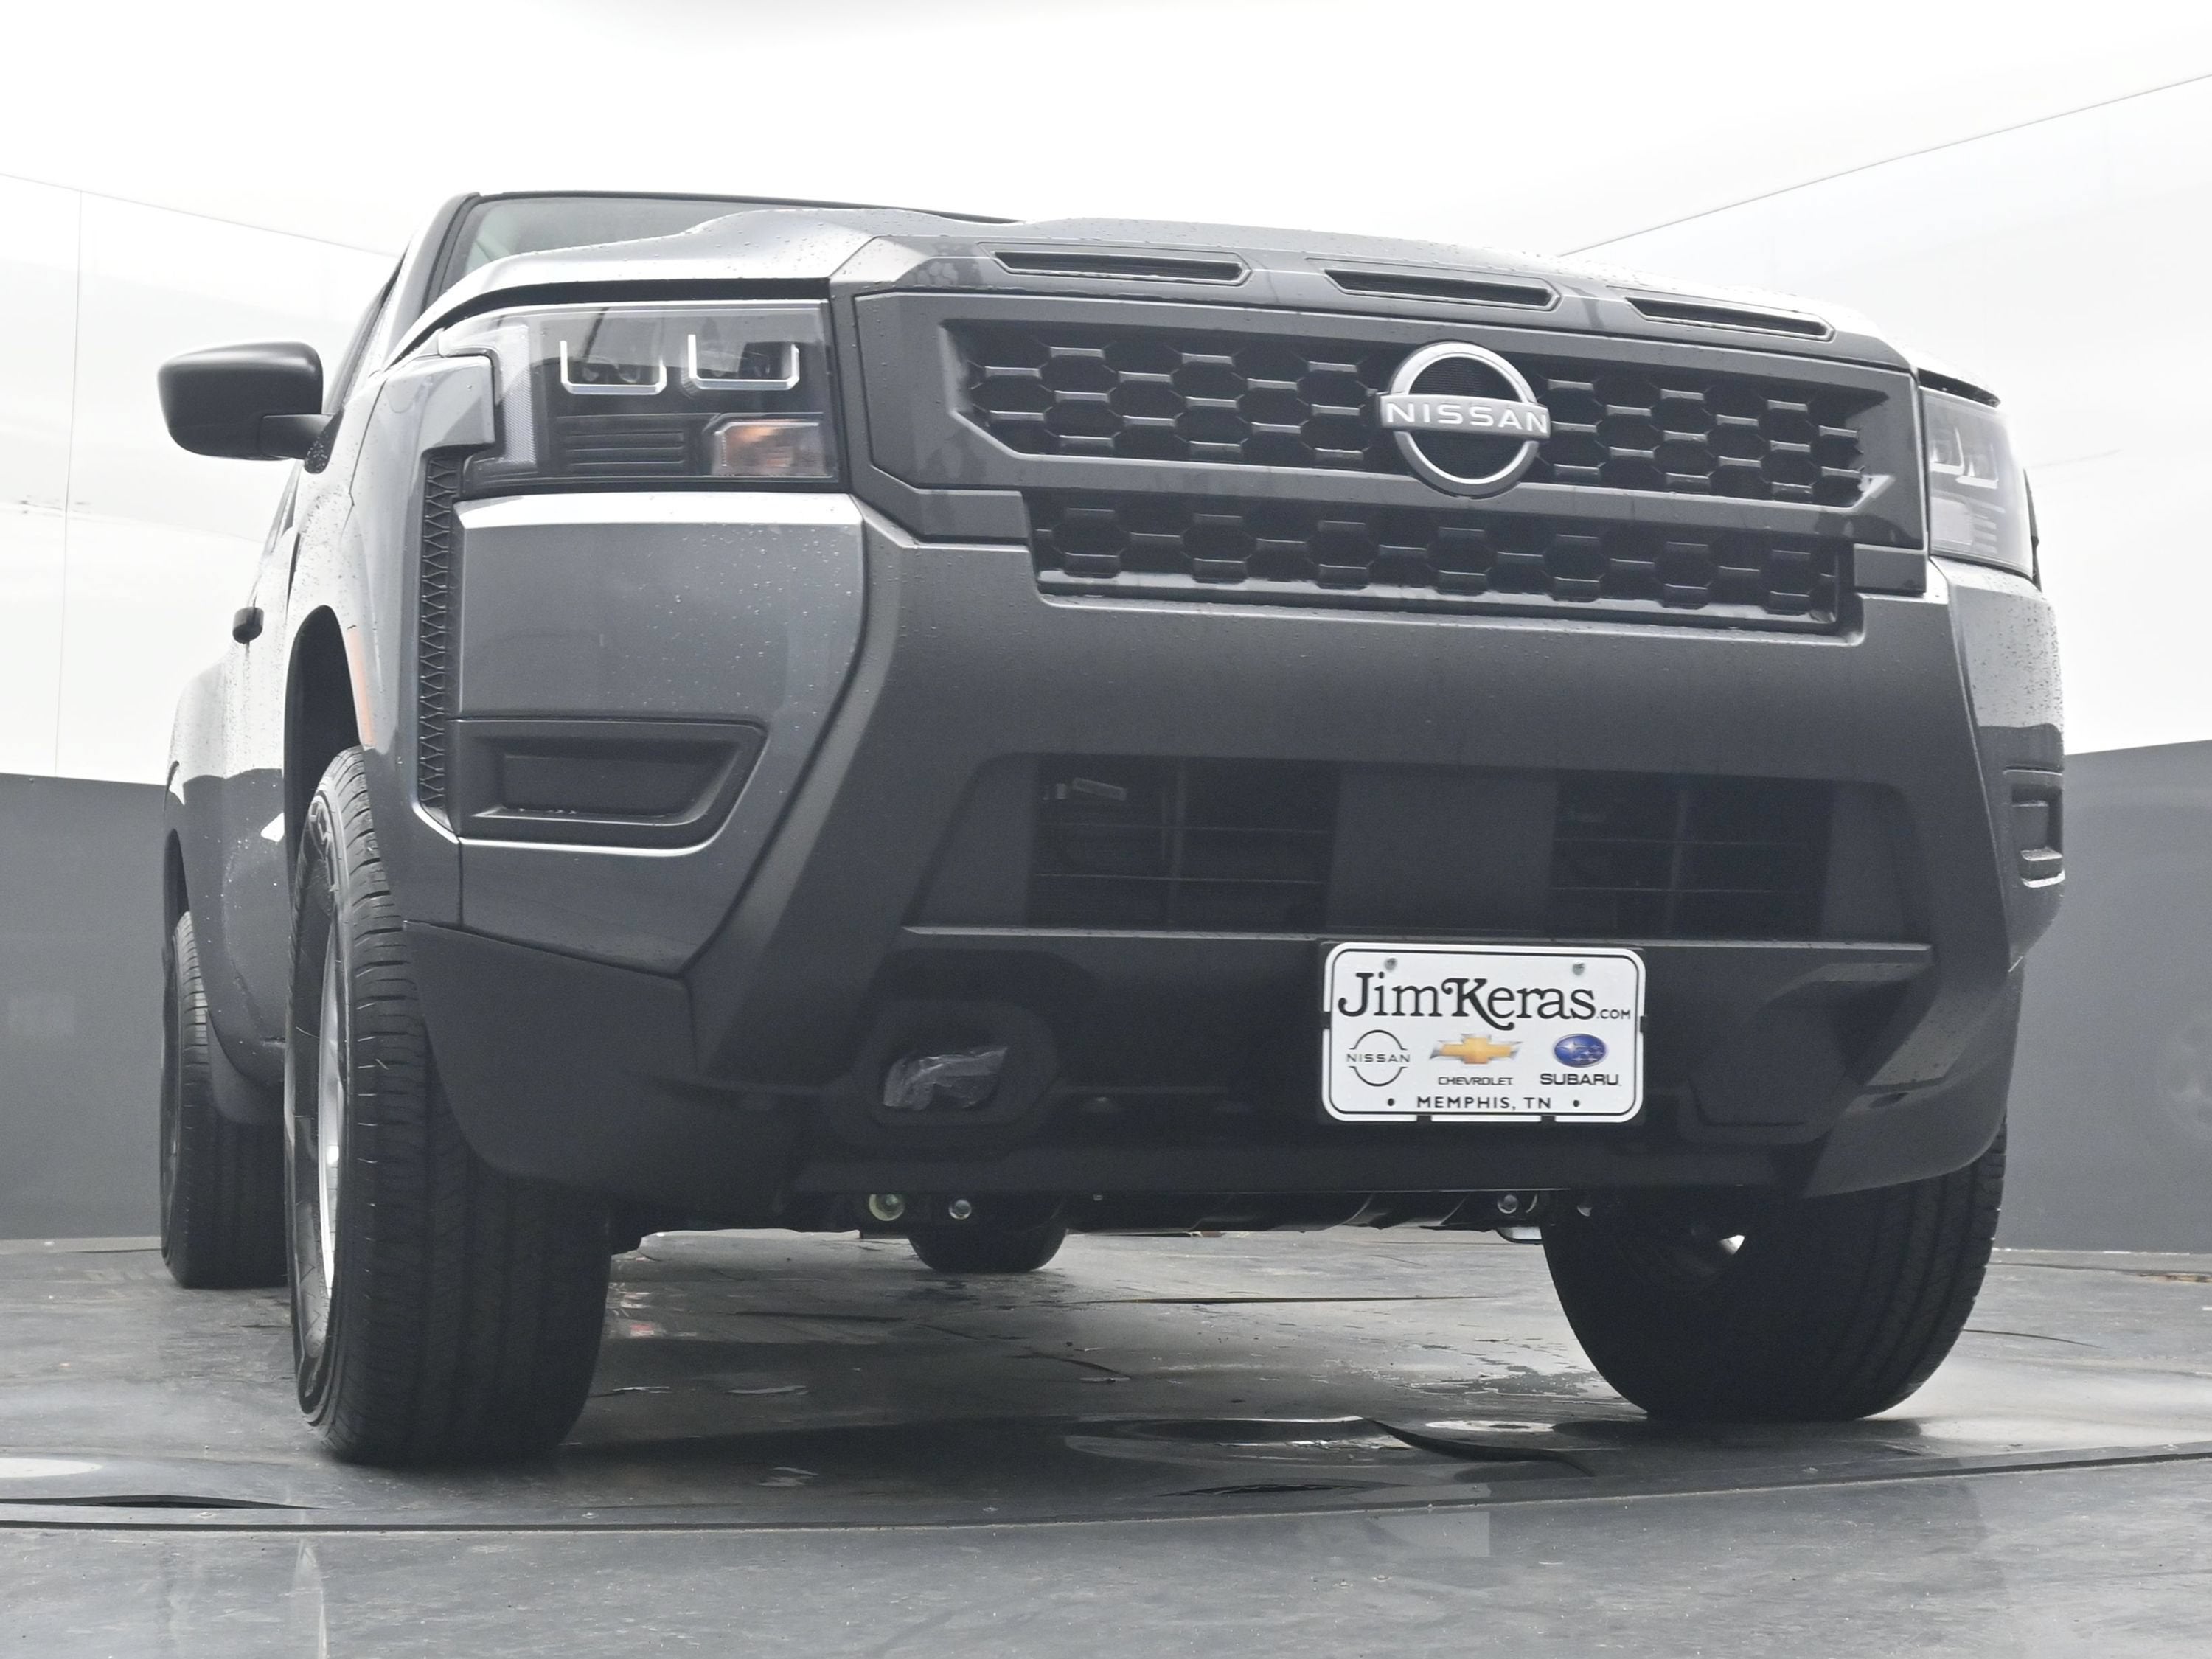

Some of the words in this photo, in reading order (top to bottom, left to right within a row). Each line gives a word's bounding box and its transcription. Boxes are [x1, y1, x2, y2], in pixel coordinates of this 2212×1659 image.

[1385, 403, 1548, 434] NISSAN
[1346, 1052, 1411, 1063] NISSAN
[1438, 1077, 1514, 1086] CHEVROLET
[1540, 1073, 1619, 1086] SUBARU
[1416, 1096, 1516, 1111] MEMPHIS,
[1523, 1096, 1551, 1109] TN
